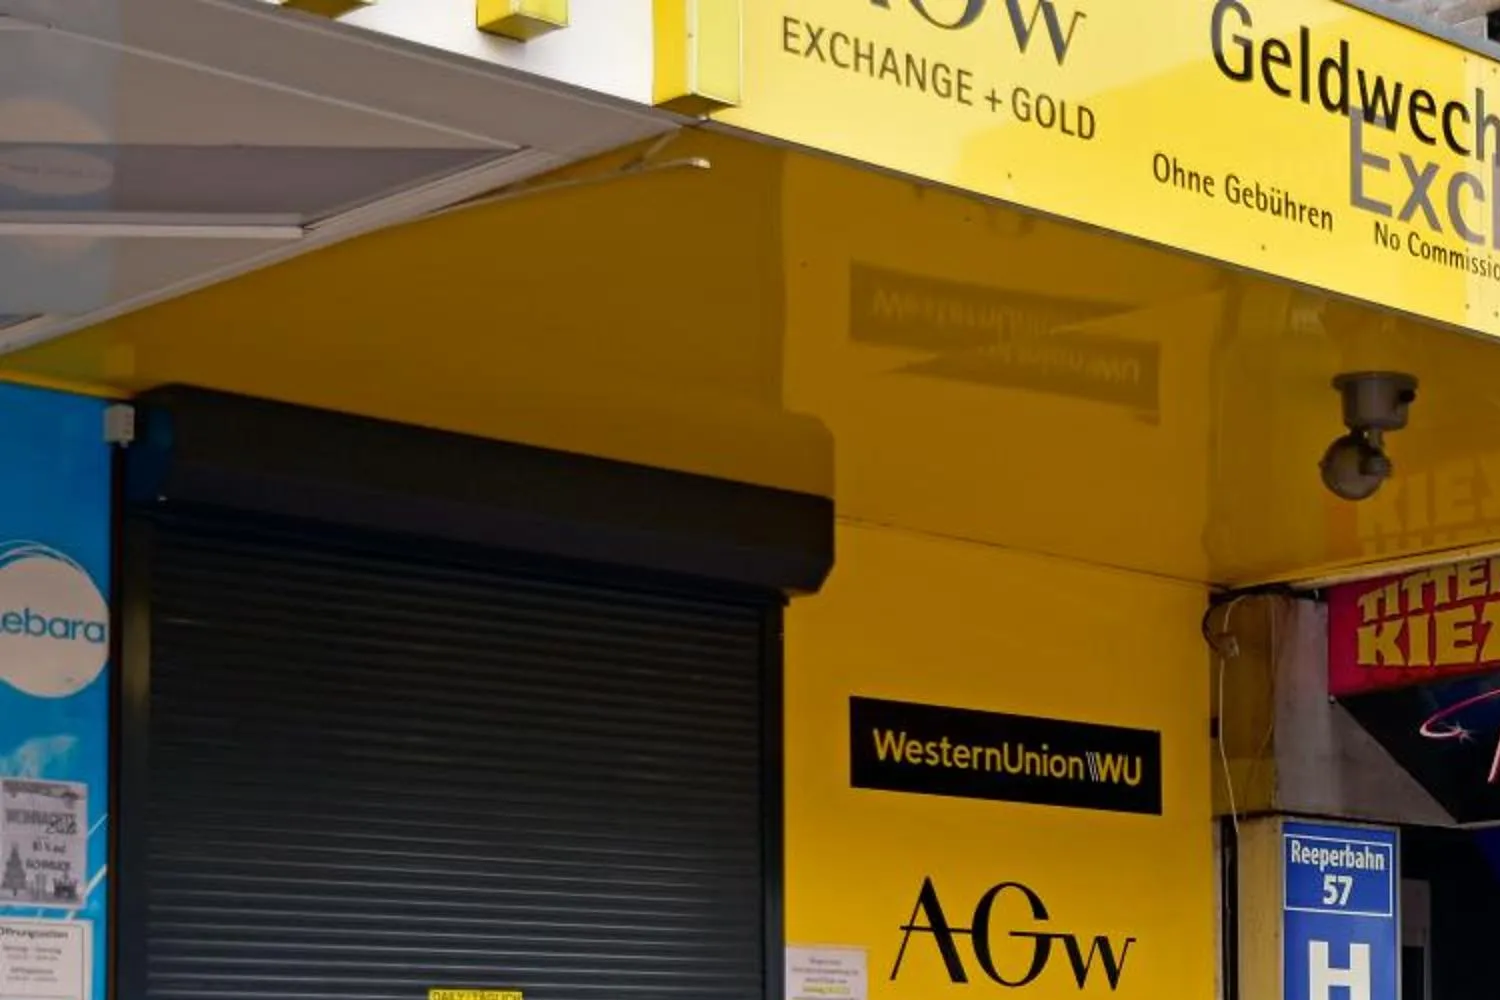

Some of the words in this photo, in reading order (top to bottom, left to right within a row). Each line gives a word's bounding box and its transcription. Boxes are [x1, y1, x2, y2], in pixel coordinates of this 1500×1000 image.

[782, 16, 973, 106] EXCHANGE
[985, 88, 1003, 112] +
[1011, 86, 1096, 140] GOLD
[1153, 153, 1215, 197] Ohne
[1225, 175, 1333, 232] Gebühren
[1374, 222, 1401, 251] No
[0, 607, 106, 644] ebara
[873, 728, 1084, 781] WesternUnion
[1291, 839, 1385, 873] Reeperbahn
[1322, 873, 1353, 906] 57
